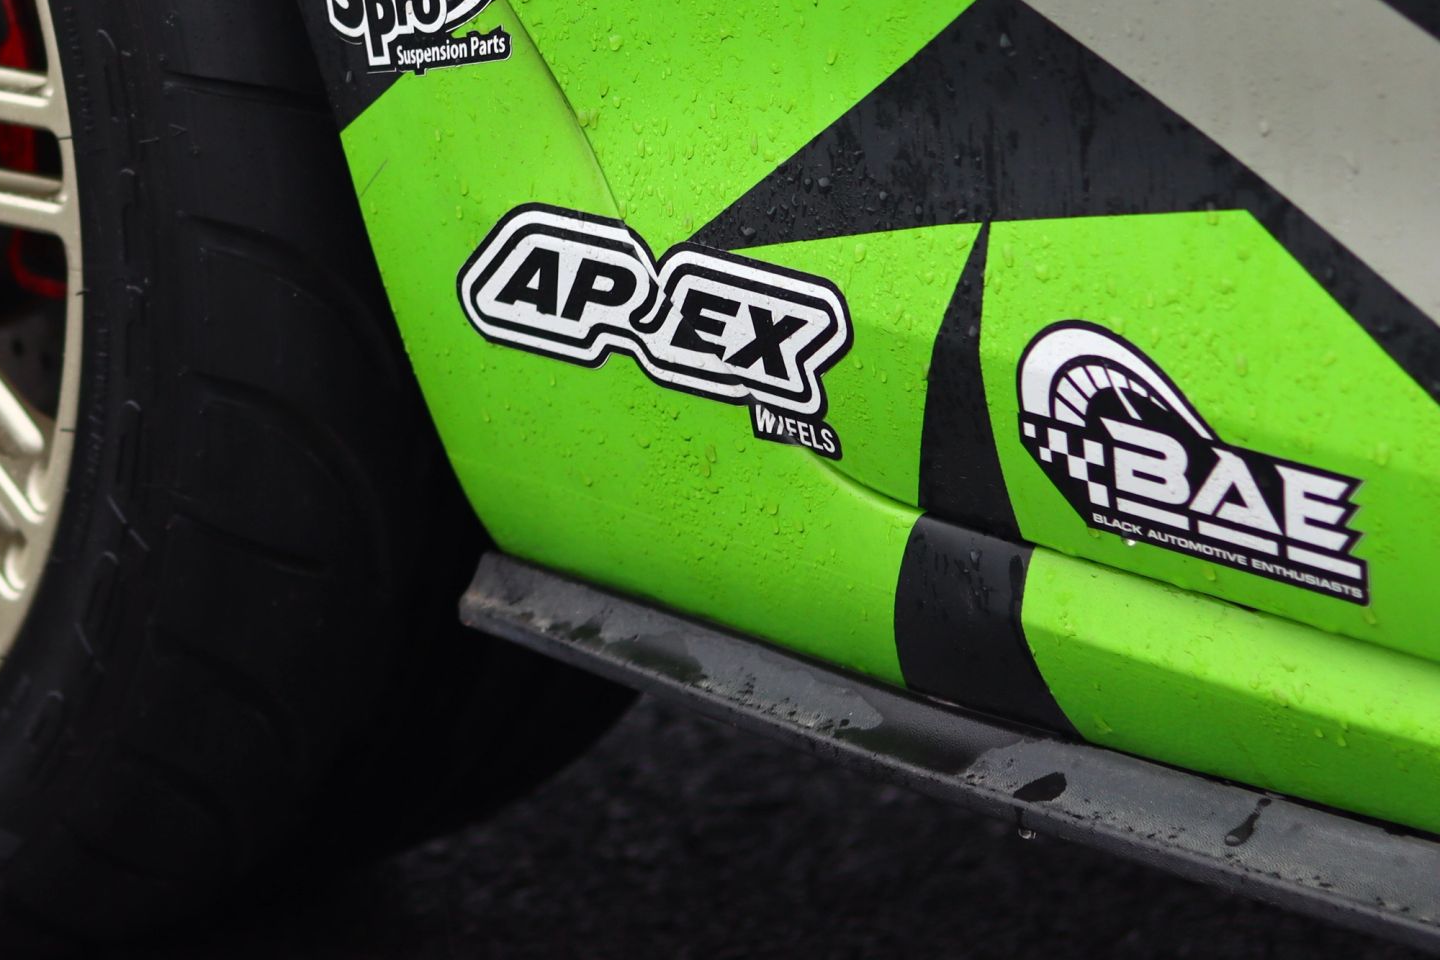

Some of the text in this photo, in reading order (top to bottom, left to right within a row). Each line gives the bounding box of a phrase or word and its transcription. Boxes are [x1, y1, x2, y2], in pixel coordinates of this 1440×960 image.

[396, 35, 506, 68] Suspension Parts
[1100, 416, 1350, 552] BAE
[1092, 512, 1364, 599] BLACK AUTOMOTIVE ENTHUSIASTS
